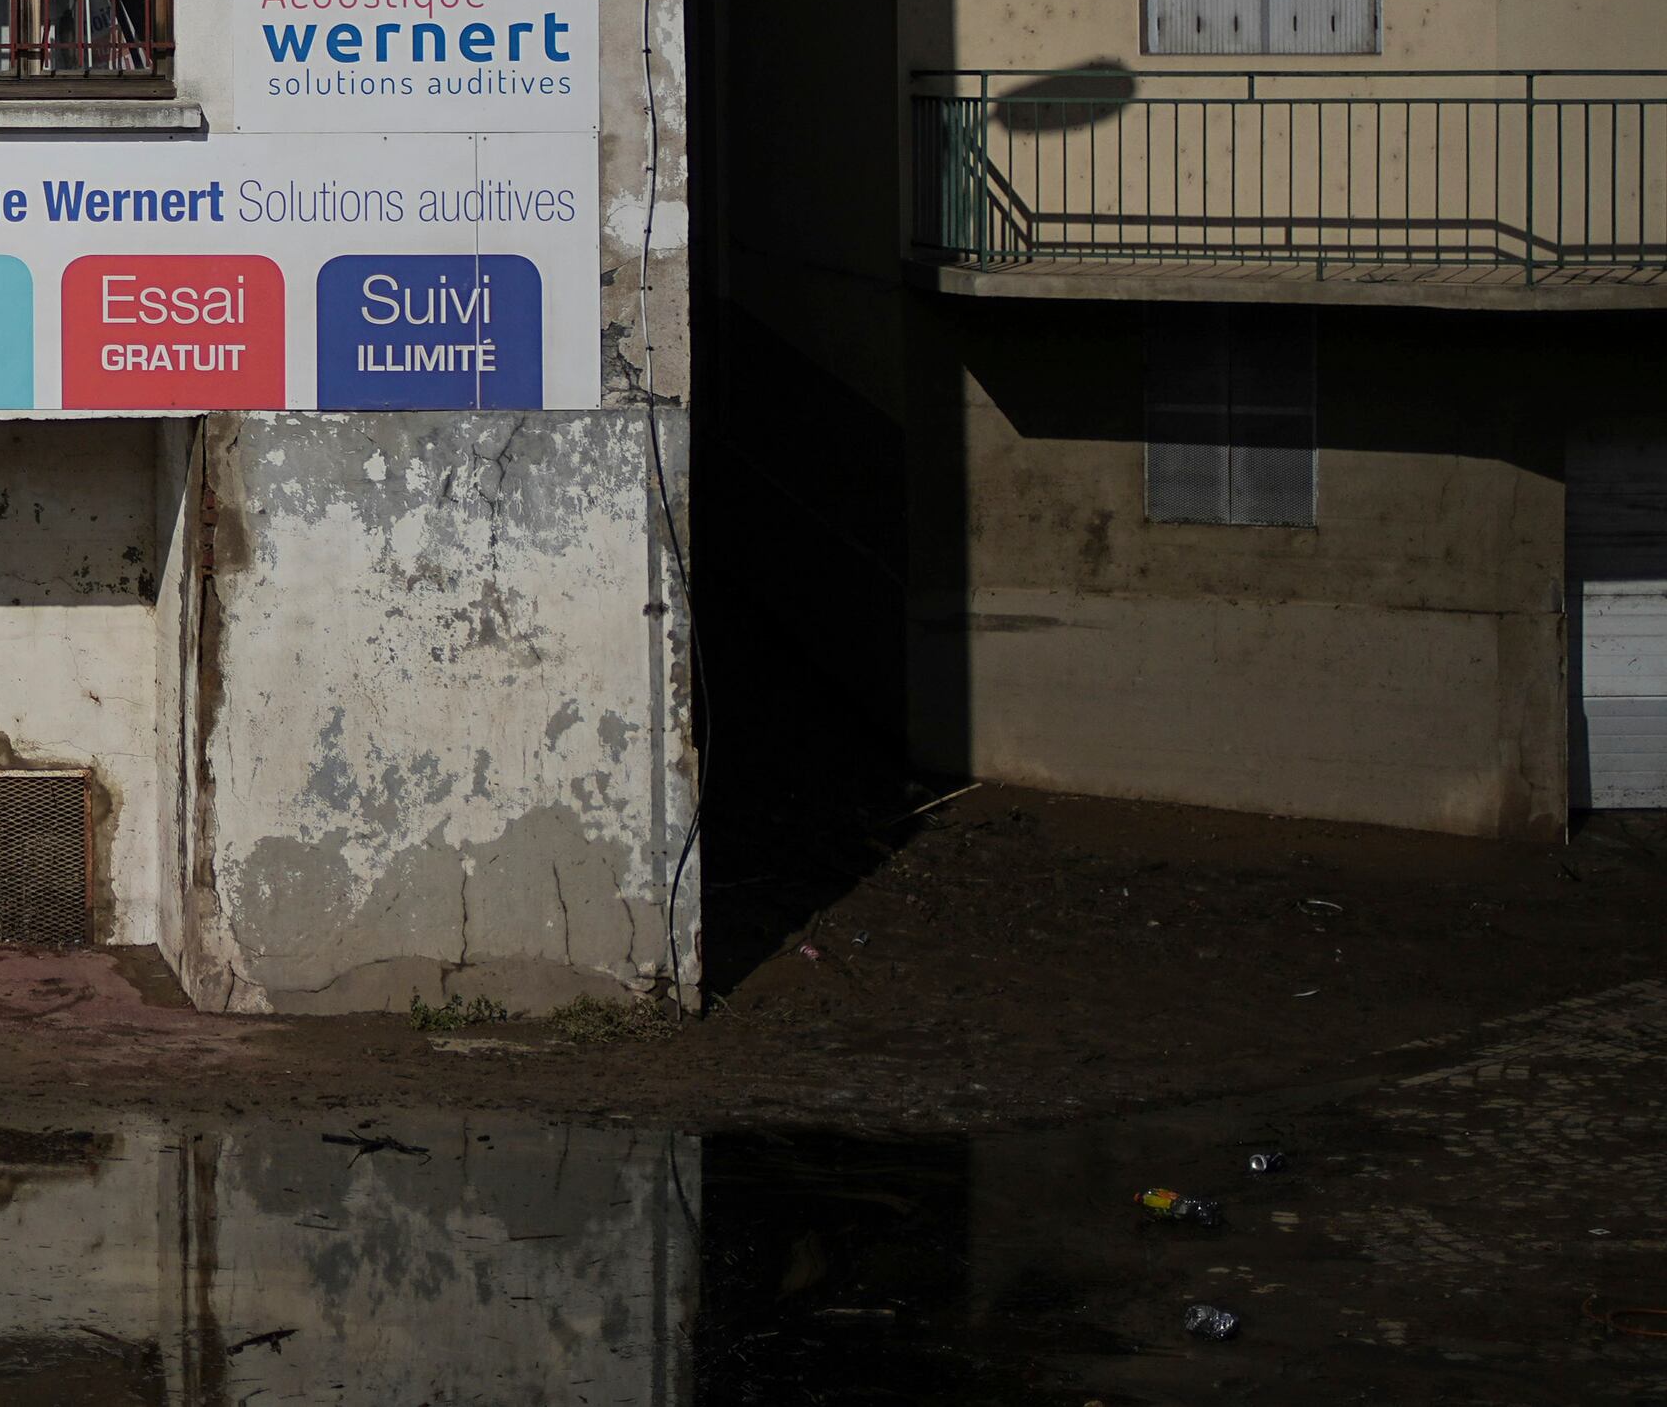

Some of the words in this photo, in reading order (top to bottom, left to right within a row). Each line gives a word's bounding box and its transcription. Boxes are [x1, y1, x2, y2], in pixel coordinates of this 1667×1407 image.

[262, 12, 572, 63] wernert
[268, 68, 414, 96] solutions
[428, 68, 572, 96] auditives
[43, 181, 225, 224] Wernert
[239, 180, 404, 224] Solutions
[418, 180, 576, 224] auditives
[102, 276, 246, 326] Essai
[361, 274, 491, 325] Suivi
[101, 344, 248, 373] GRATUIT
[358, 338, 497, 372] ILLIMITÉ
